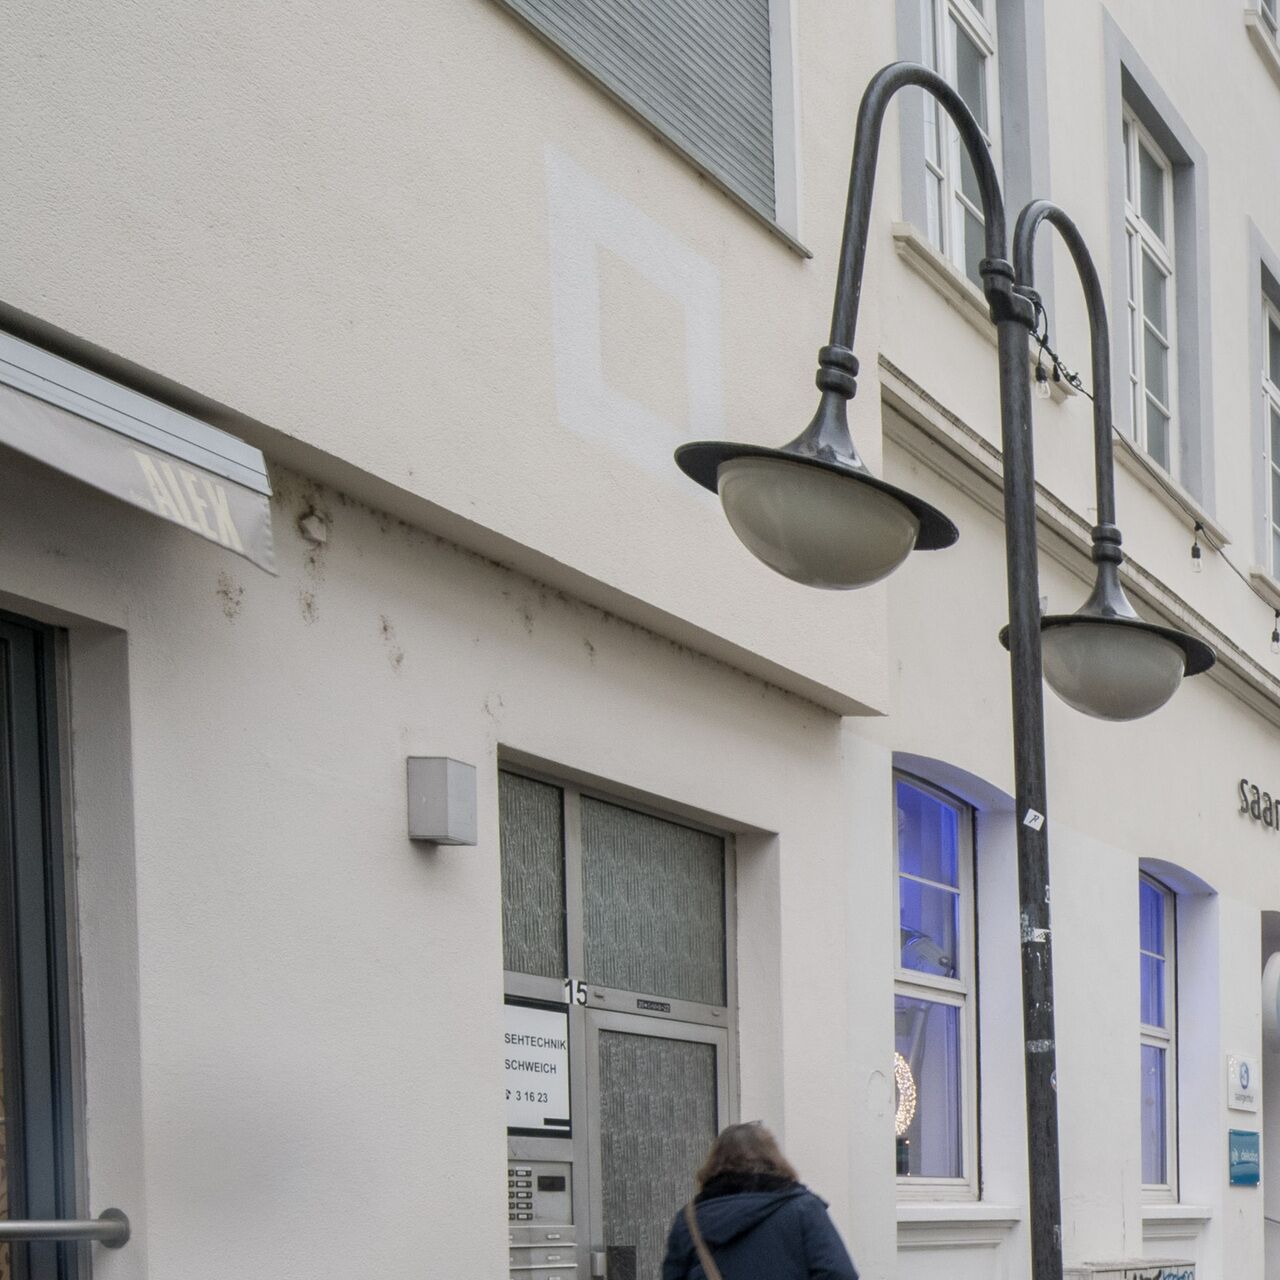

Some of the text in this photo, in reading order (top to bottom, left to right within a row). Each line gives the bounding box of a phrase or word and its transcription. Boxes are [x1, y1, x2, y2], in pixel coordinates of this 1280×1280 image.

[133, 450, 244, 550] ALEX
[565, 979, 588, 1006] 15
[504, 1032, 567, 1050] SEHTECHNIK
[504, 1058, 557, 1074] SCHWEICH
[516, 1090, 549, 1104] 3 16 23
